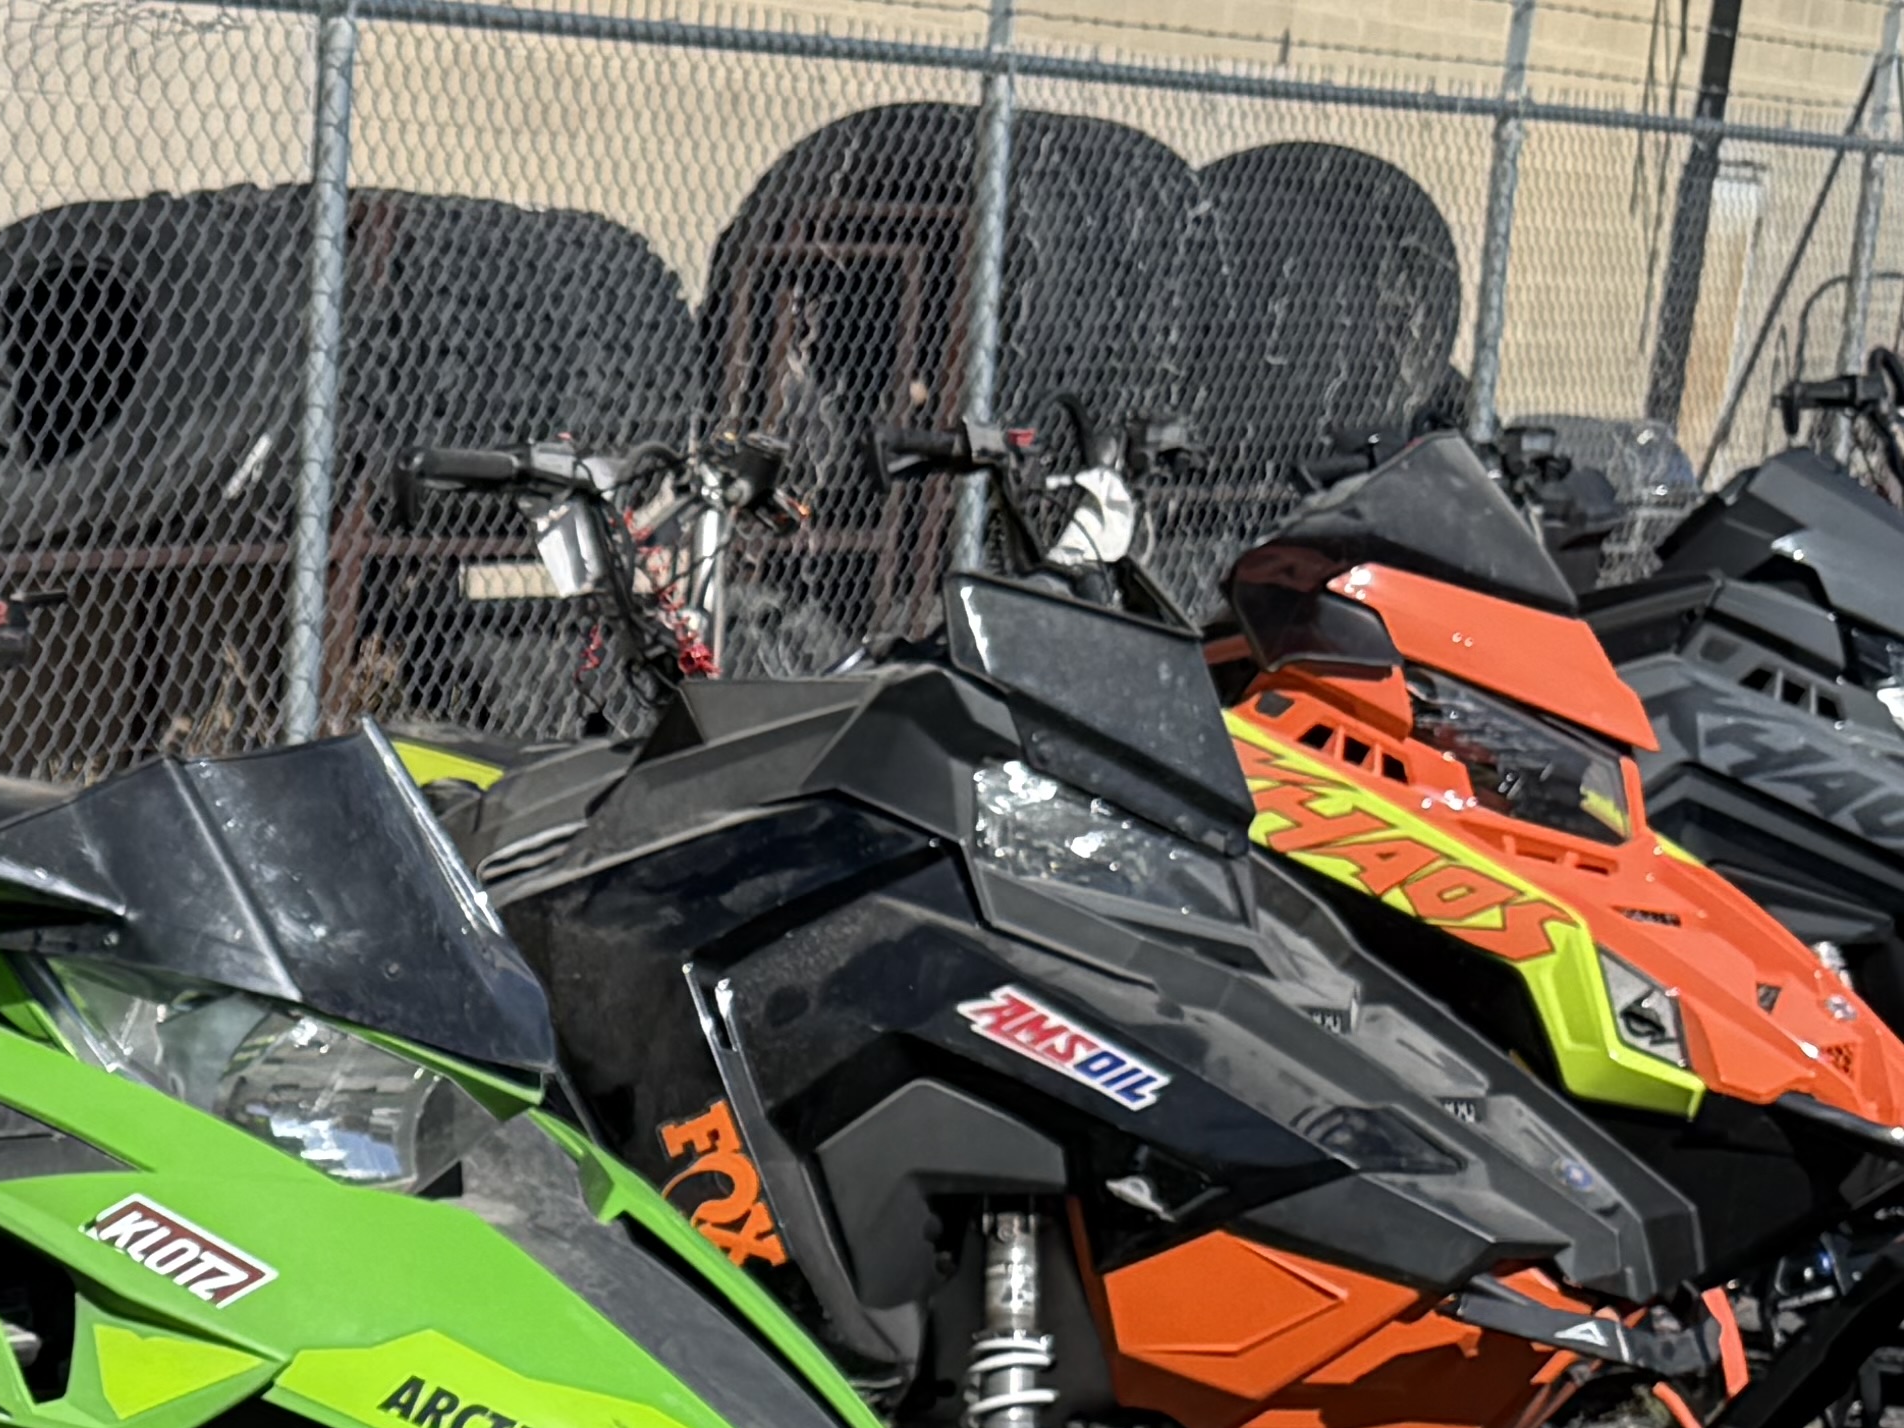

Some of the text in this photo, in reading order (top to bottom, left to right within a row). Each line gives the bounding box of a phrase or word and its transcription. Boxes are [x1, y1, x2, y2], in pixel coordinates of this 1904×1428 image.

[966, 992, 1159, 1104] AMSOIL
[661, 1099, 788, 1269] FOX
[99, 1210, 249, 1302] KLOTZ
